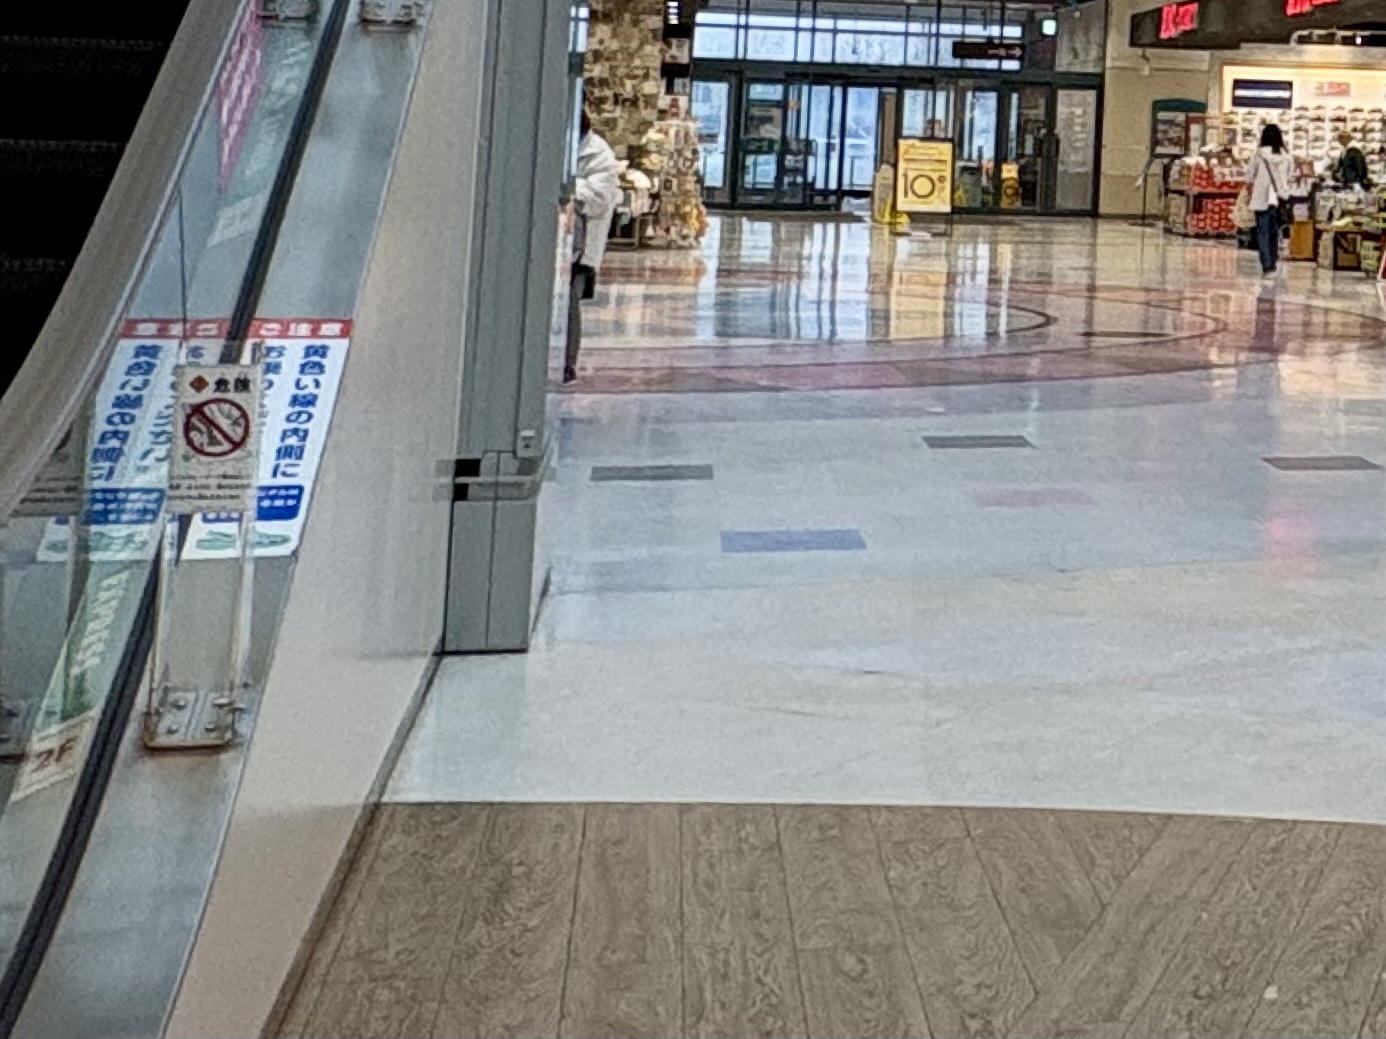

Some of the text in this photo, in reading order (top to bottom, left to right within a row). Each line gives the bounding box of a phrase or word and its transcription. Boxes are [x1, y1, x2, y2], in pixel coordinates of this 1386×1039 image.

[213, 376, 252, 394] 危険
[272, 344, 330, 480] 黄色い線の内側に
[31, 735, 79, 774] 2F
